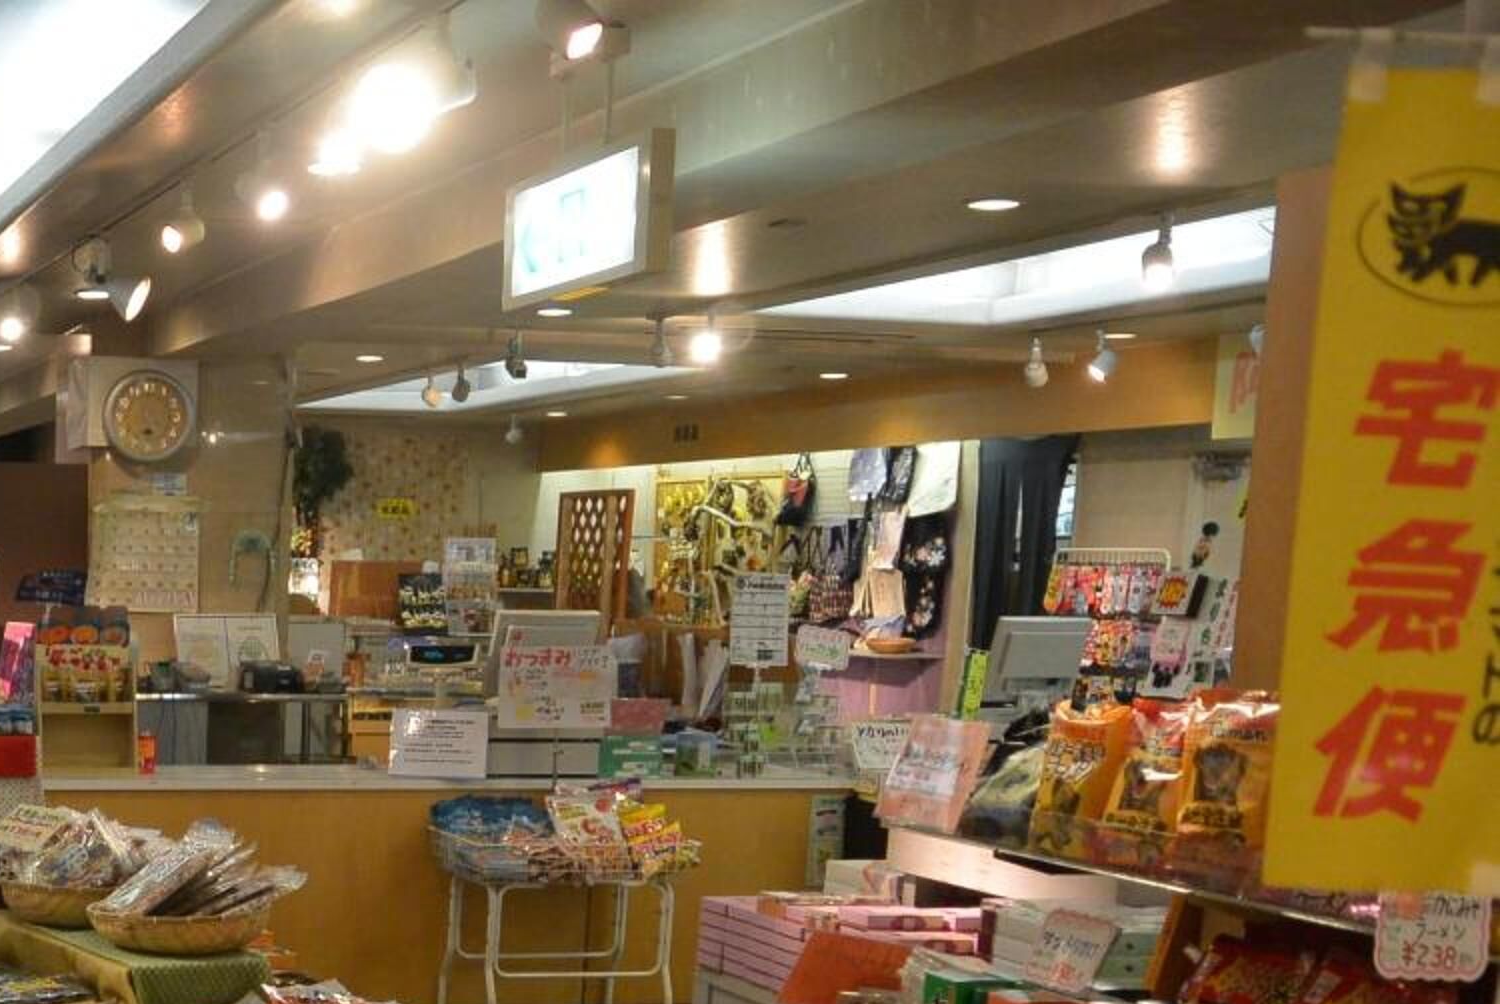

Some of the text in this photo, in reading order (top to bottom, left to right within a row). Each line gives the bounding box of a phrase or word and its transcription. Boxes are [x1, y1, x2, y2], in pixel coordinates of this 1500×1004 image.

[1313, 348, 1499, 825] 宅急便
[1400, 940, 1458, 970] ¥238
